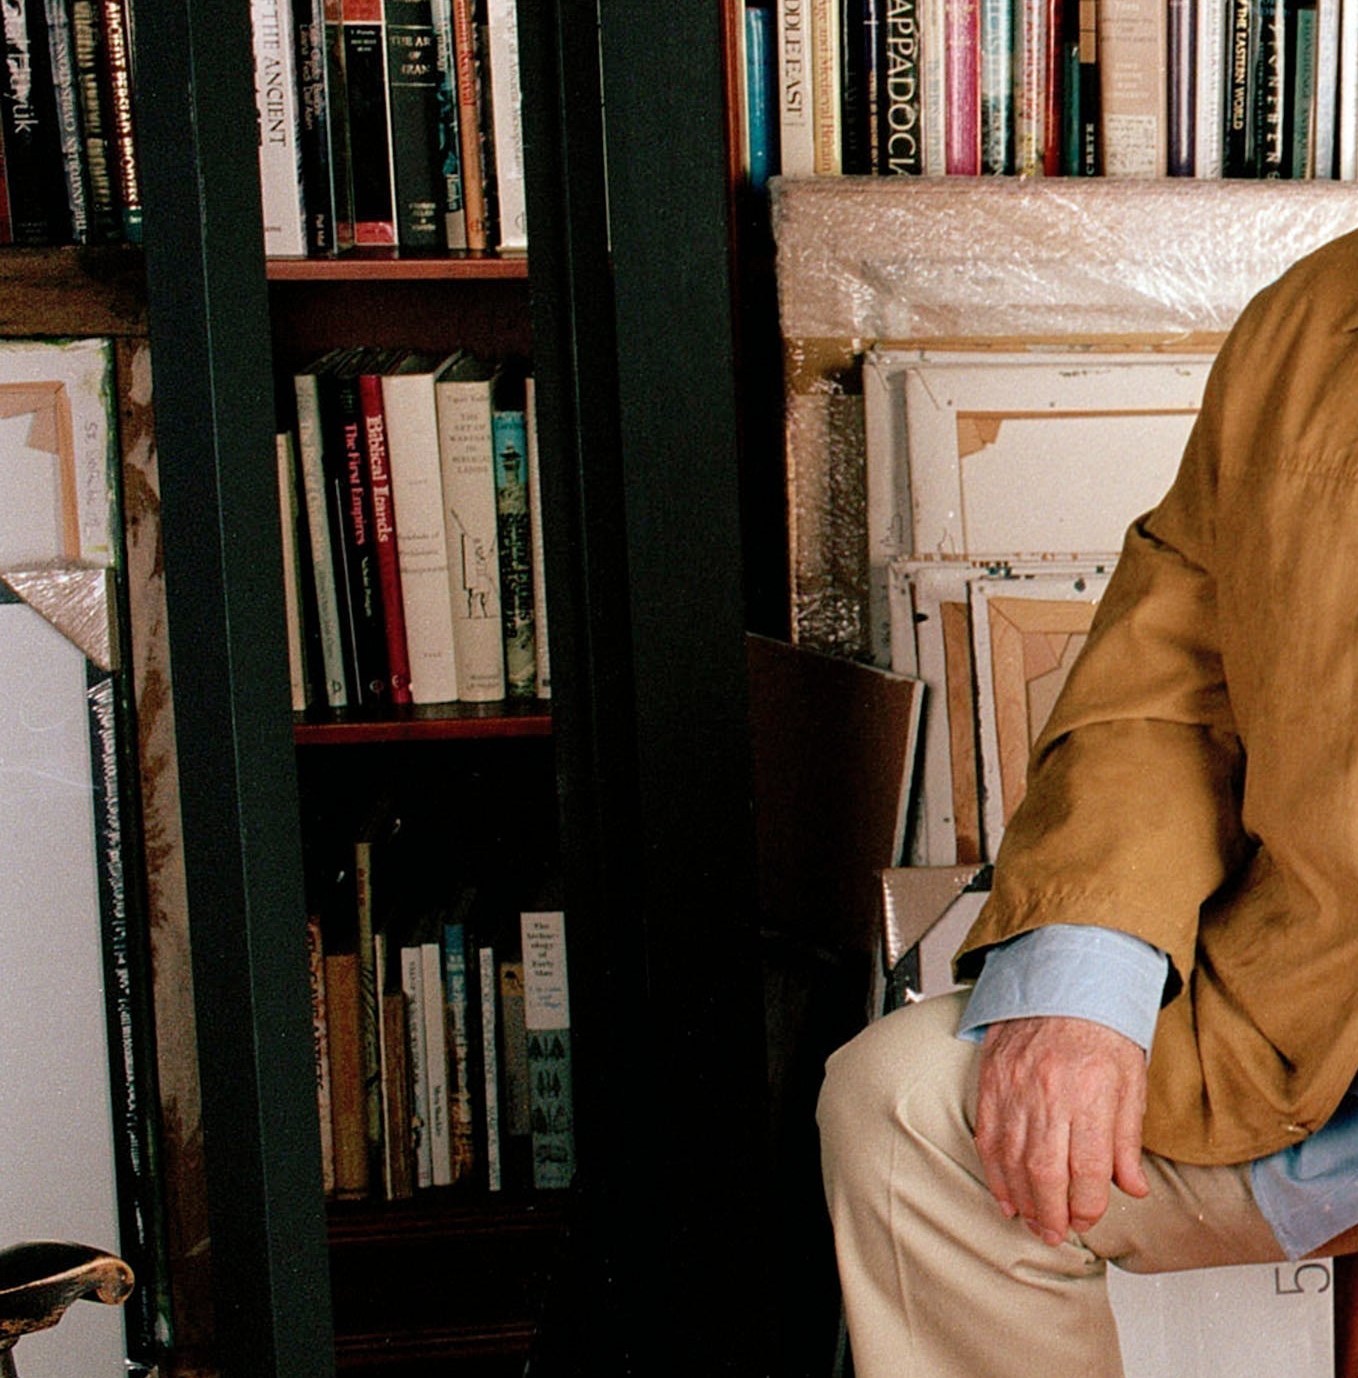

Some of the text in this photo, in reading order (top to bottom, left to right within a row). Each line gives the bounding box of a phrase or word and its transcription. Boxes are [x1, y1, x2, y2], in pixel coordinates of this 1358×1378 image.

[262, 9, 280, 51] THE
[265, 56, 286, 148] ANCIENT
[344, 423, 365, 546] The First Empires
[364, 414, 394, 544] Biblical Lands
[1274, 1262, 1331, 1296] 5
